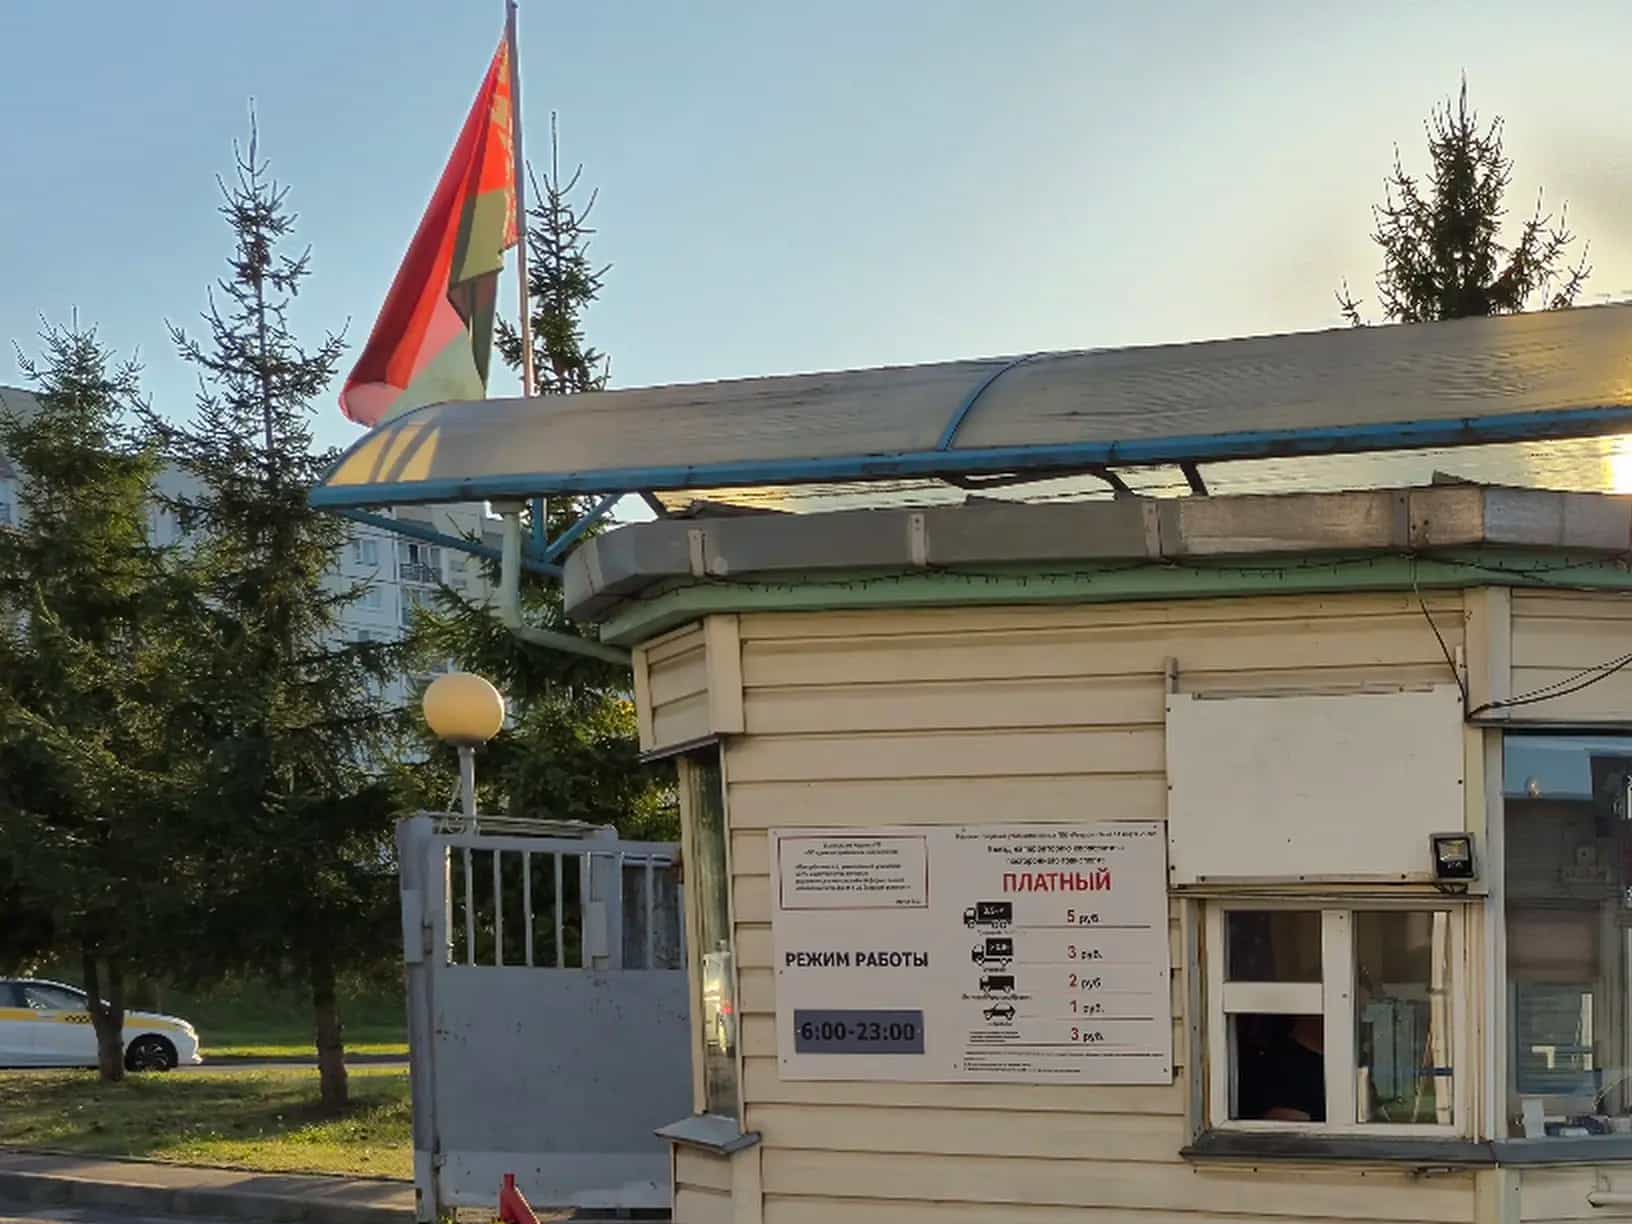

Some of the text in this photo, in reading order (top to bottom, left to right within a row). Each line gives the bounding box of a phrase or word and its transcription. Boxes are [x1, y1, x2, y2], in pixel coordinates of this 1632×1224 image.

[1002, 867, 1112, 892] ПЛАТНЫЙ
[1066, 909, 1076, 923] 5
[1067, 945, 1077, 959] 3
[785, 952, 929, 967] РЕЖИМ РАБОТЫ
[1069, 973, 1078, 988] 2
[1069, 1000, 1078, 1013] 1
[801, 1021, 916, 1041] 6:00-23:00
[1071, 1027, 1080, 1041] 3
